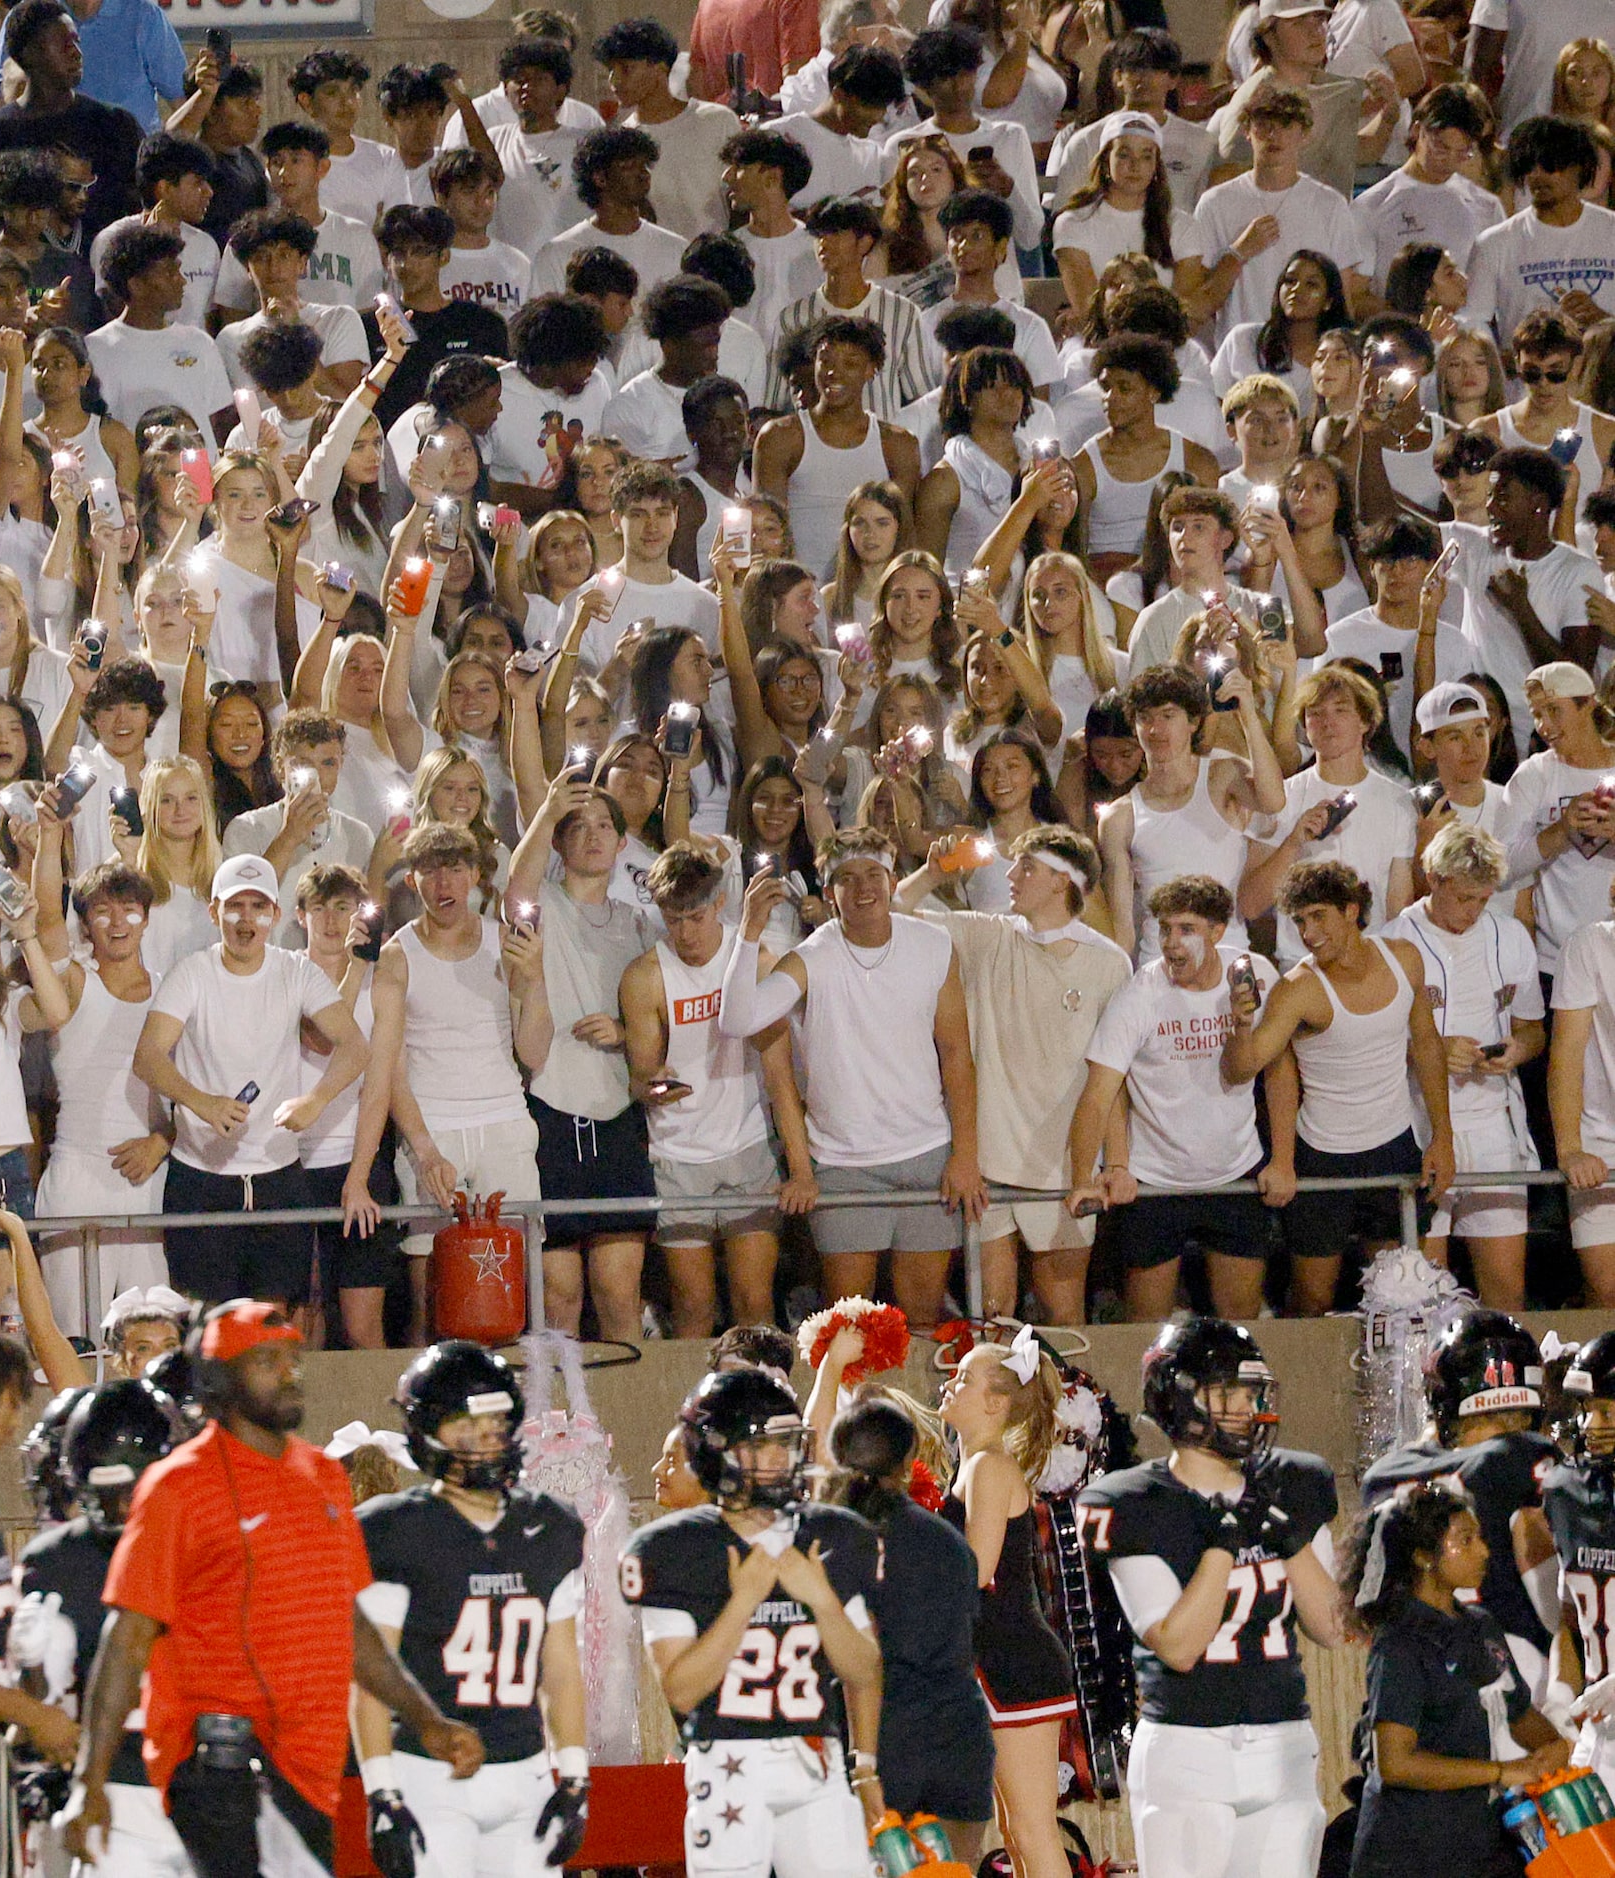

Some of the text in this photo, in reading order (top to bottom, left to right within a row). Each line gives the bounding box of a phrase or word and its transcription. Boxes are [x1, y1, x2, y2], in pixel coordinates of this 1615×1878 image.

[299, 252, 353, 287] MA
[1157, 1020, 1183, 1036] AIR
[1474, 1390, 1529, 1409] Riddell
[1204, 1558, 1294, 1664] 77
[442, 1596, 546, 1707] 40
[716, 1624, 826, 1722] 28
